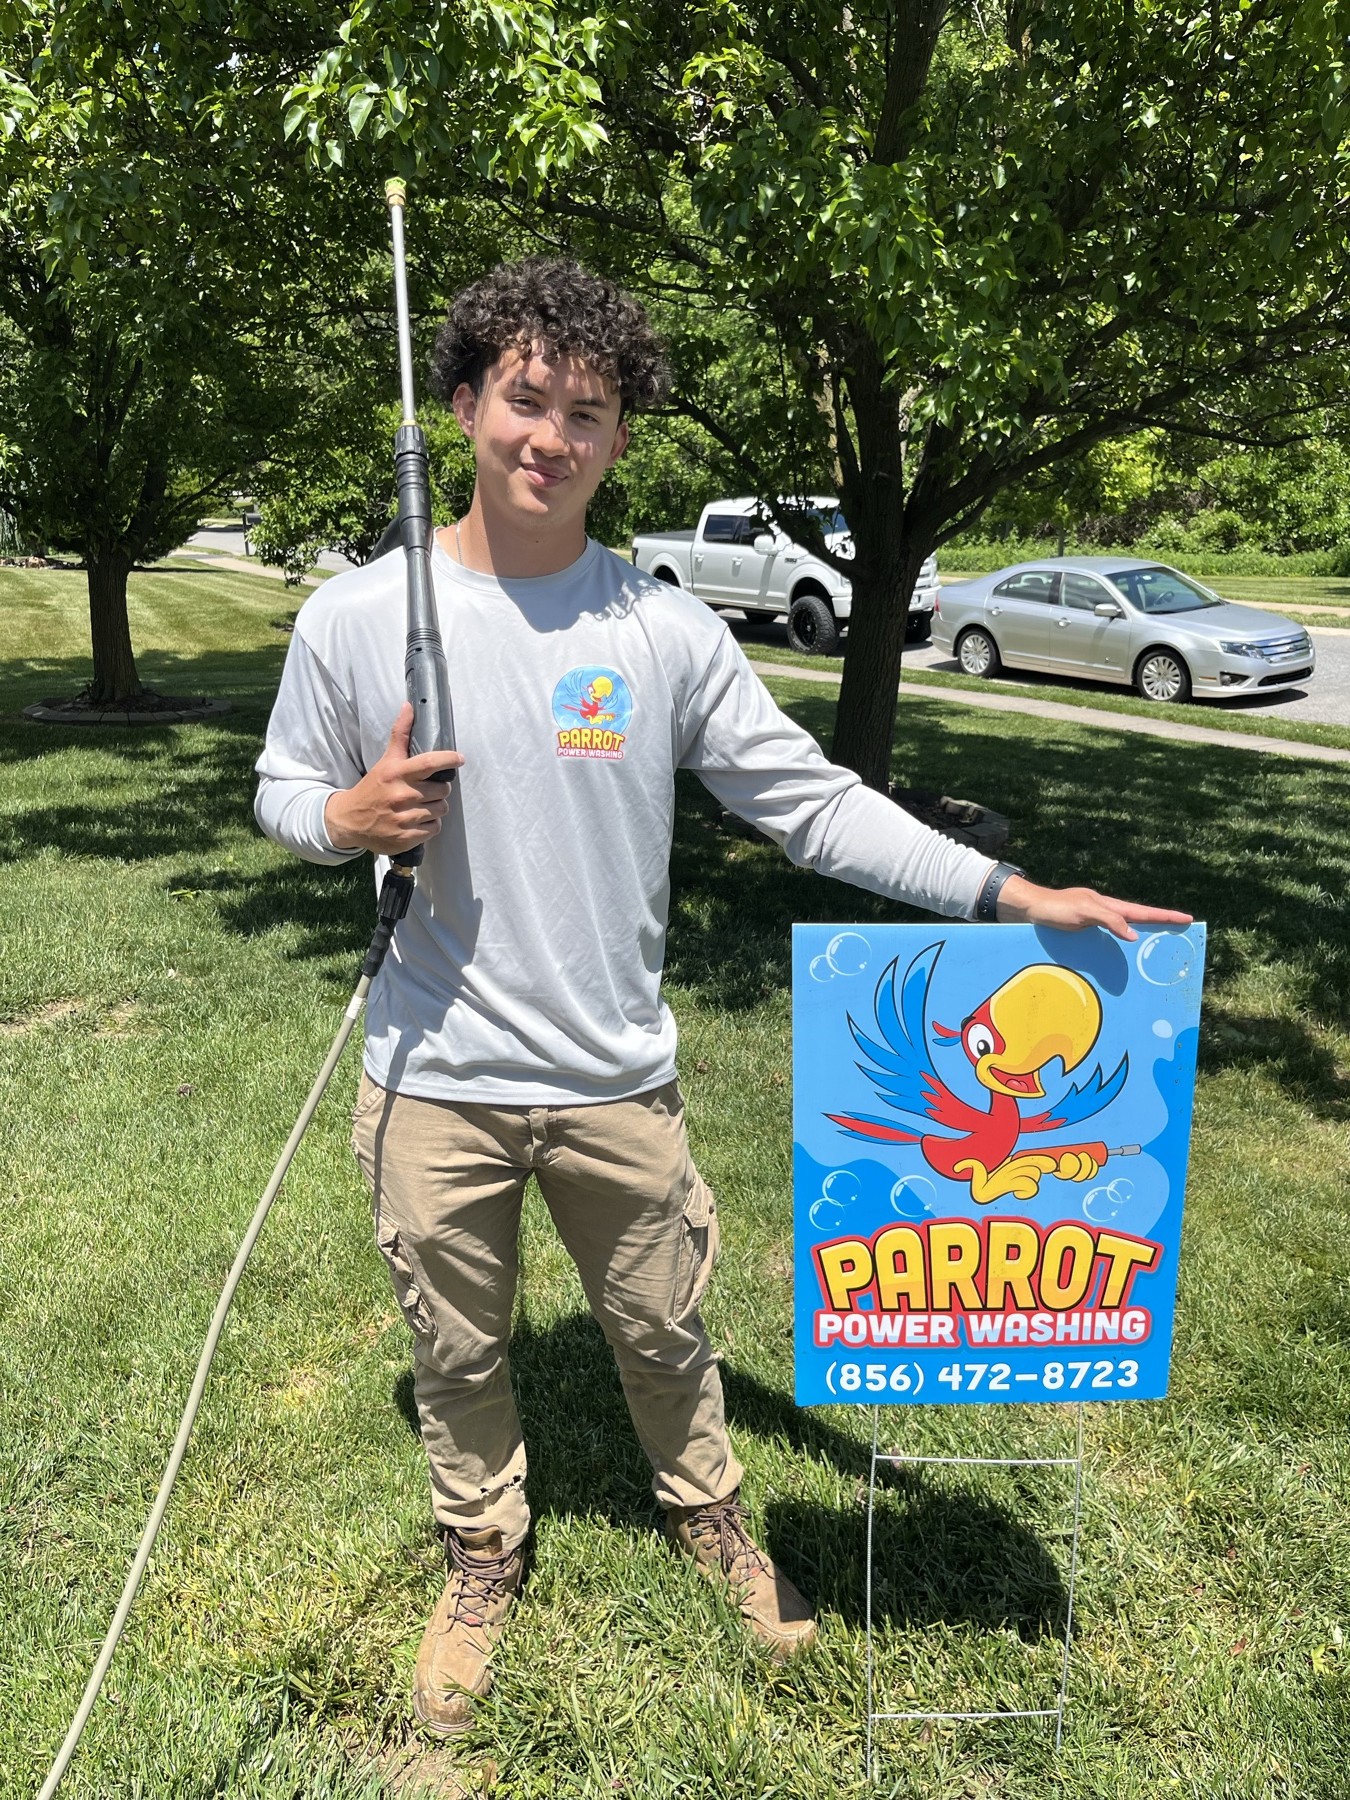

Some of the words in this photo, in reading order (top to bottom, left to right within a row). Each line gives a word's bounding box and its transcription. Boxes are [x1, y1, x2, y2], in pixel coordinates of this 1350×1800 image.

[558, 748, 586, 756] POWER
[589, 749, 623, 759] WASHING
[559, 728, 624, 750] PARROT
[817, 1220, 1157, 1311] PARROT
[819, 1313, 955, 1343] POWER
[969, 1310, 1147, 1342] WASHING
[825, 1360, 924, 1396] (856)
[938, 1359, 1138, 1391] 472-8723
